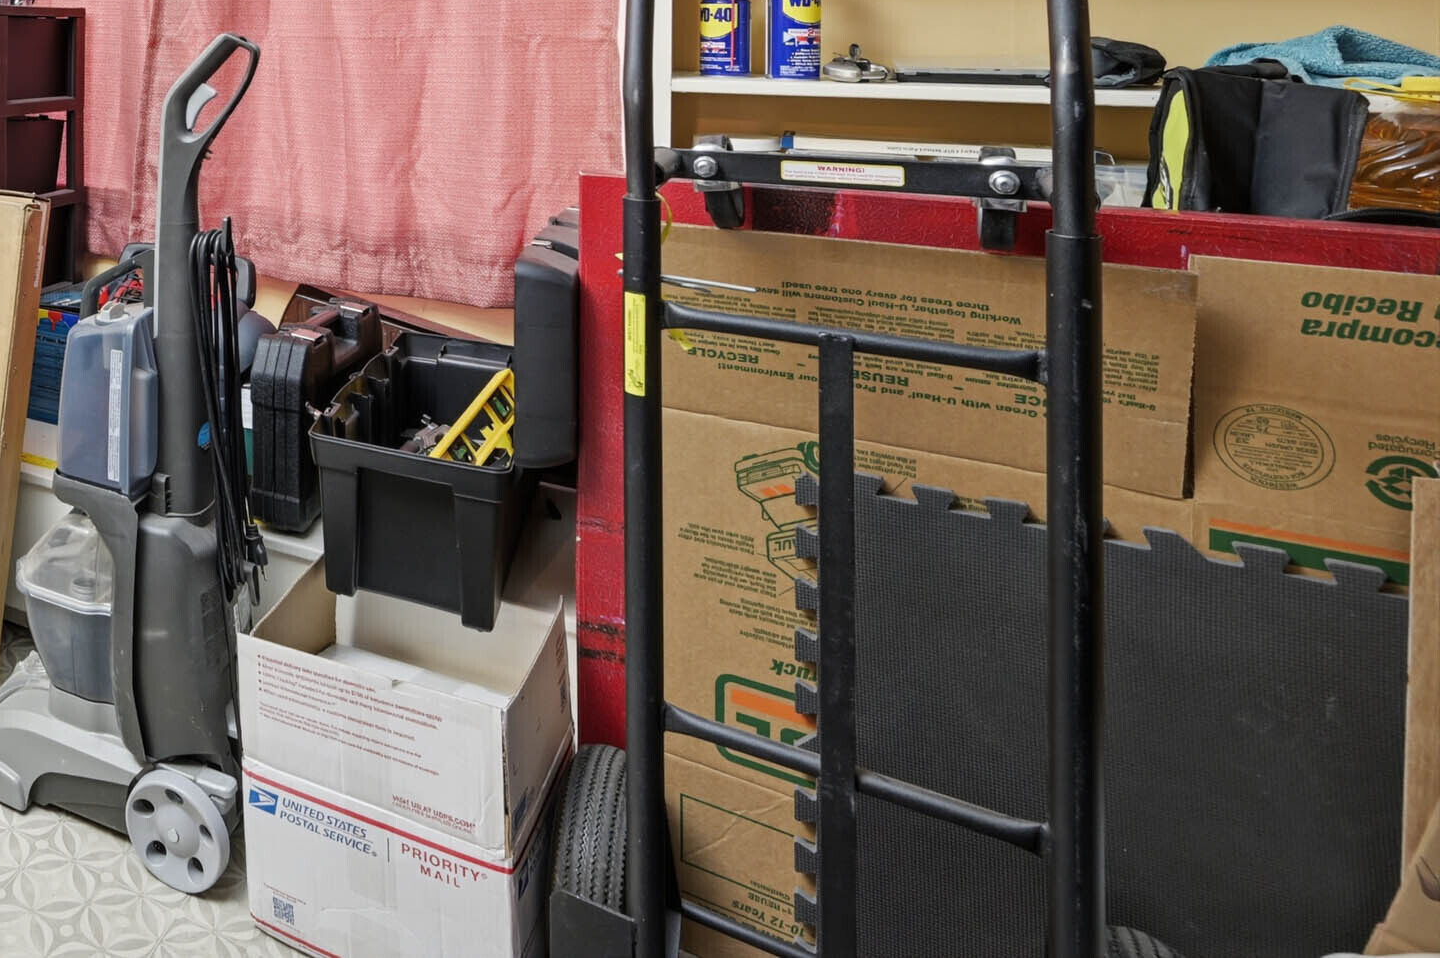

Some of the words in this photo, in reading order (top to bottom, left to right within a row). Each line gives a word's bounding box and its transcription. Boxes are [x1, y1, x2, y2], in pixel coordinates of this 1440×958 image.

[817, 164, 866, 174] WARNING!
[782, 281, 812, 293] used!
[782, 290, 801, 299] will
[814, 284, 838, 295] tree
[841, 287, 863, 298] one
[866, 289, 897, 300] every
[804, 293, 865, 307] Customers
[868, 299, 908, 312] U-Haul
[900, 294, 918, 304] for
[921, 296, 953, 308] trees
[911, 304, 966, 319] together,
[956, 301, 990, 313] three
[1300, 291, 1424, 324] Recibo
[969, 310, 1022, 326] Working
[1300, 319, 1440, 350] compra
[688, 346, 759, 364] RECYCLE
[718, 362, 794, 380] Environment!
[798, 372, 818, 383] our
[852, 369, 909, 387] REUSE
[881, 386, 904, 397] and
[961, 398, 991, 411] with
[995, 404, 1038, 419] Green
[769, 659, 817, 682] ruck
[282, 796, 325, 822] UNITED
[326, 815, 367, 839] STATES
[280, 809, 321, 836] POSTAL
[323, 827, 372, 855] SERVICE
[401, 843, 480, 882] PRIORITY
[420, 864, 461, 889] MAIL
[731, 899, 766, 921] Years
[770, 916, 805, 939] 10-12
